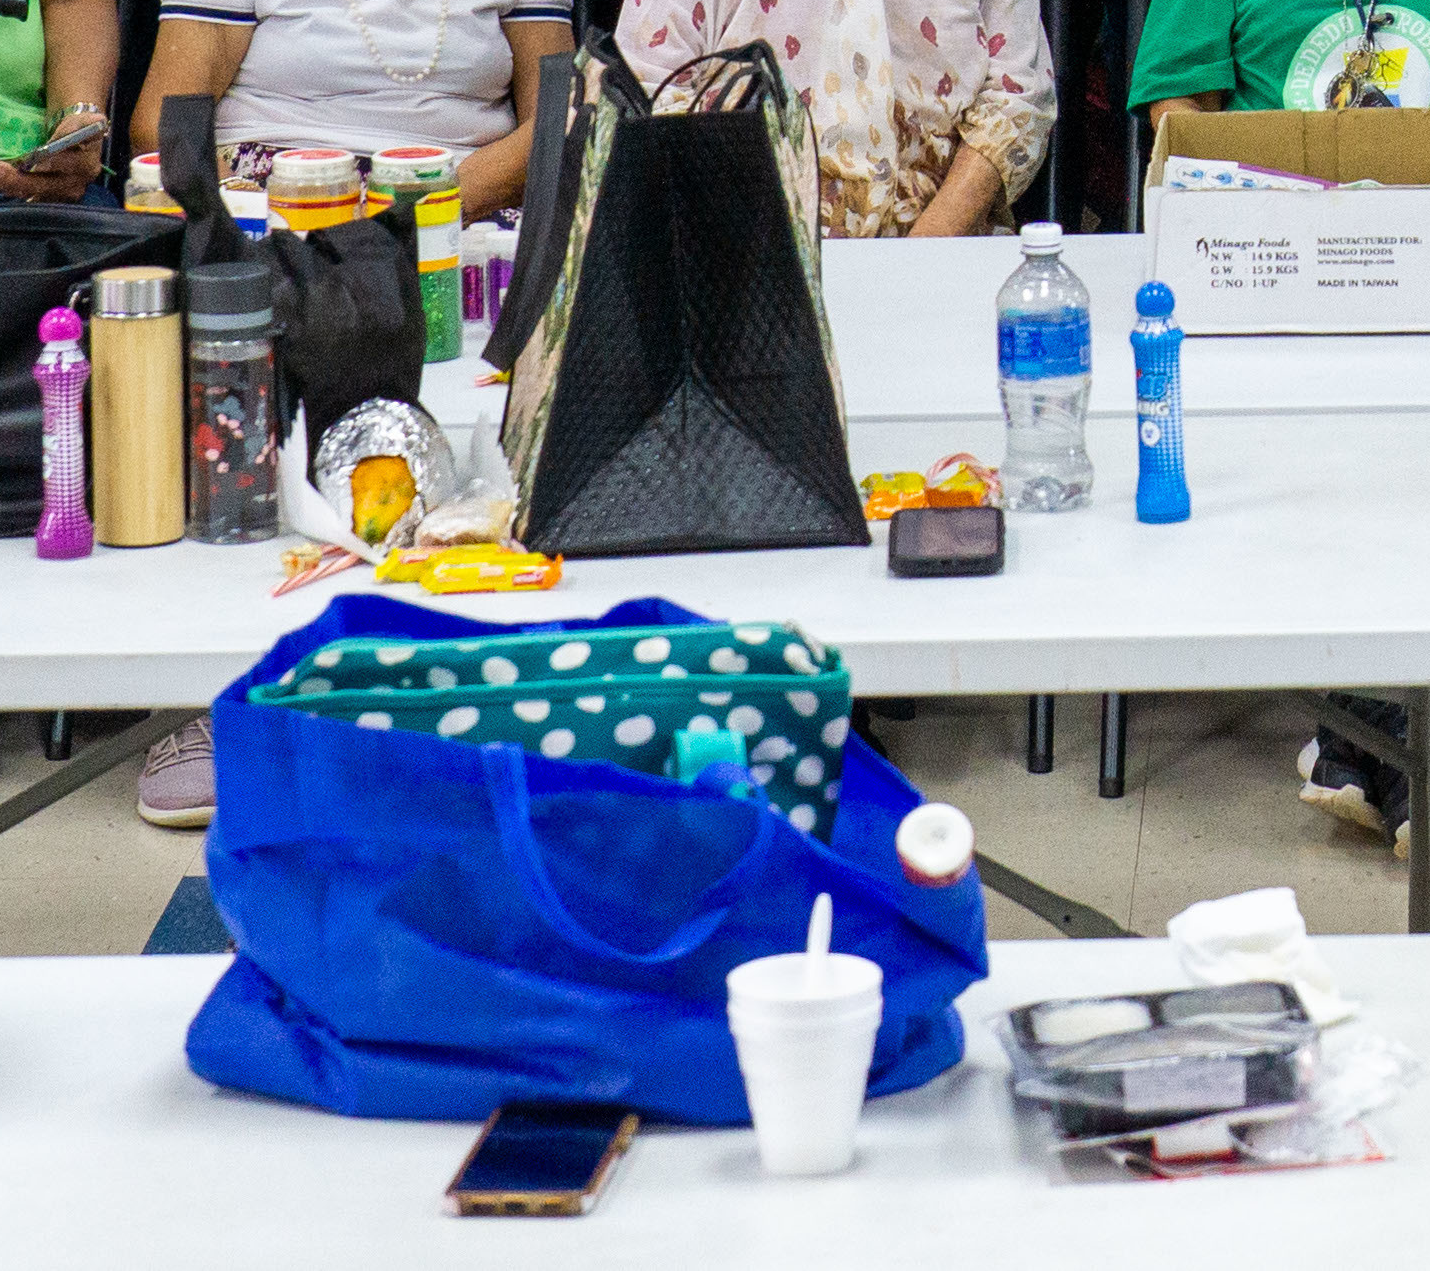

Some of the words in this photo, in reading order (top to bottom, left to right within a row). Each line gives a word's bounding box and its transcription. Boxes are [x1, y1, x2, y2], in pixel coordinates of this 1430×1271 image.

[1290, 15, 1356, 90] DEDEDO
[1210, 238, 1255, 250] Minago
[1257, 237, 1290, 248] Foods
[1317, 237, 1397, 245] MANUFACTURED
[1275, 252, 1299, 261] KGS
[1276, 266, 1299, 274] KGS
[1317, 279, 1345, 287] MADE
[1349, 279, 1358, 287] IN
[1361, 279, 1399, 287] TAIWAN
